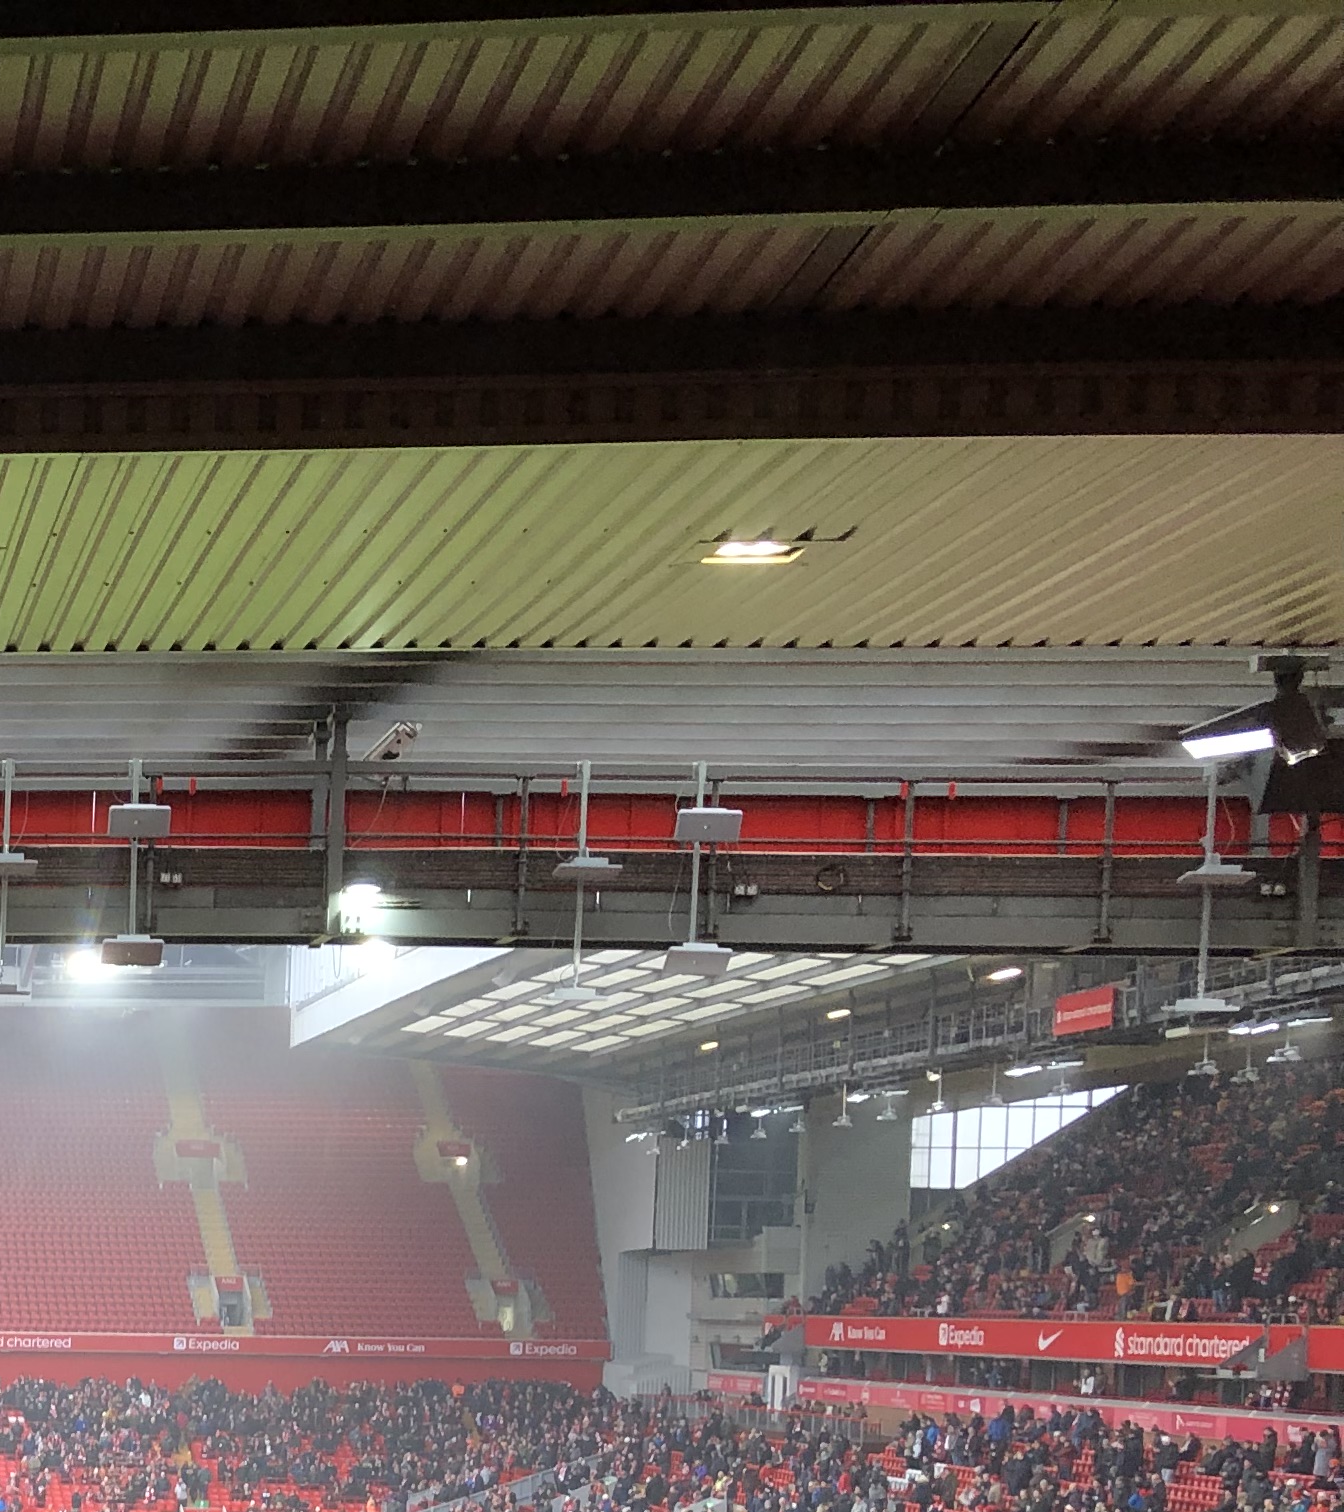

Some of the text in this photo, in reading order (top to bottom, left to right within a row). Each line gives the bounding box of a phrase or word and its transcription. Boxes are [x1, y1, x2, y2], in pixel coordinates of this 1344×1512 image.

[7, 1336, 72, 1350] chartered
[949, 1326, 985, 1347] Expedia
[188, 1337, 240, 1352] Expedia
[357, 1342, 425, 1354] Know You Can
[525, 1343, 578, 1356] Expedia
[1127, 1328, 1251, 1361] standard chartered
